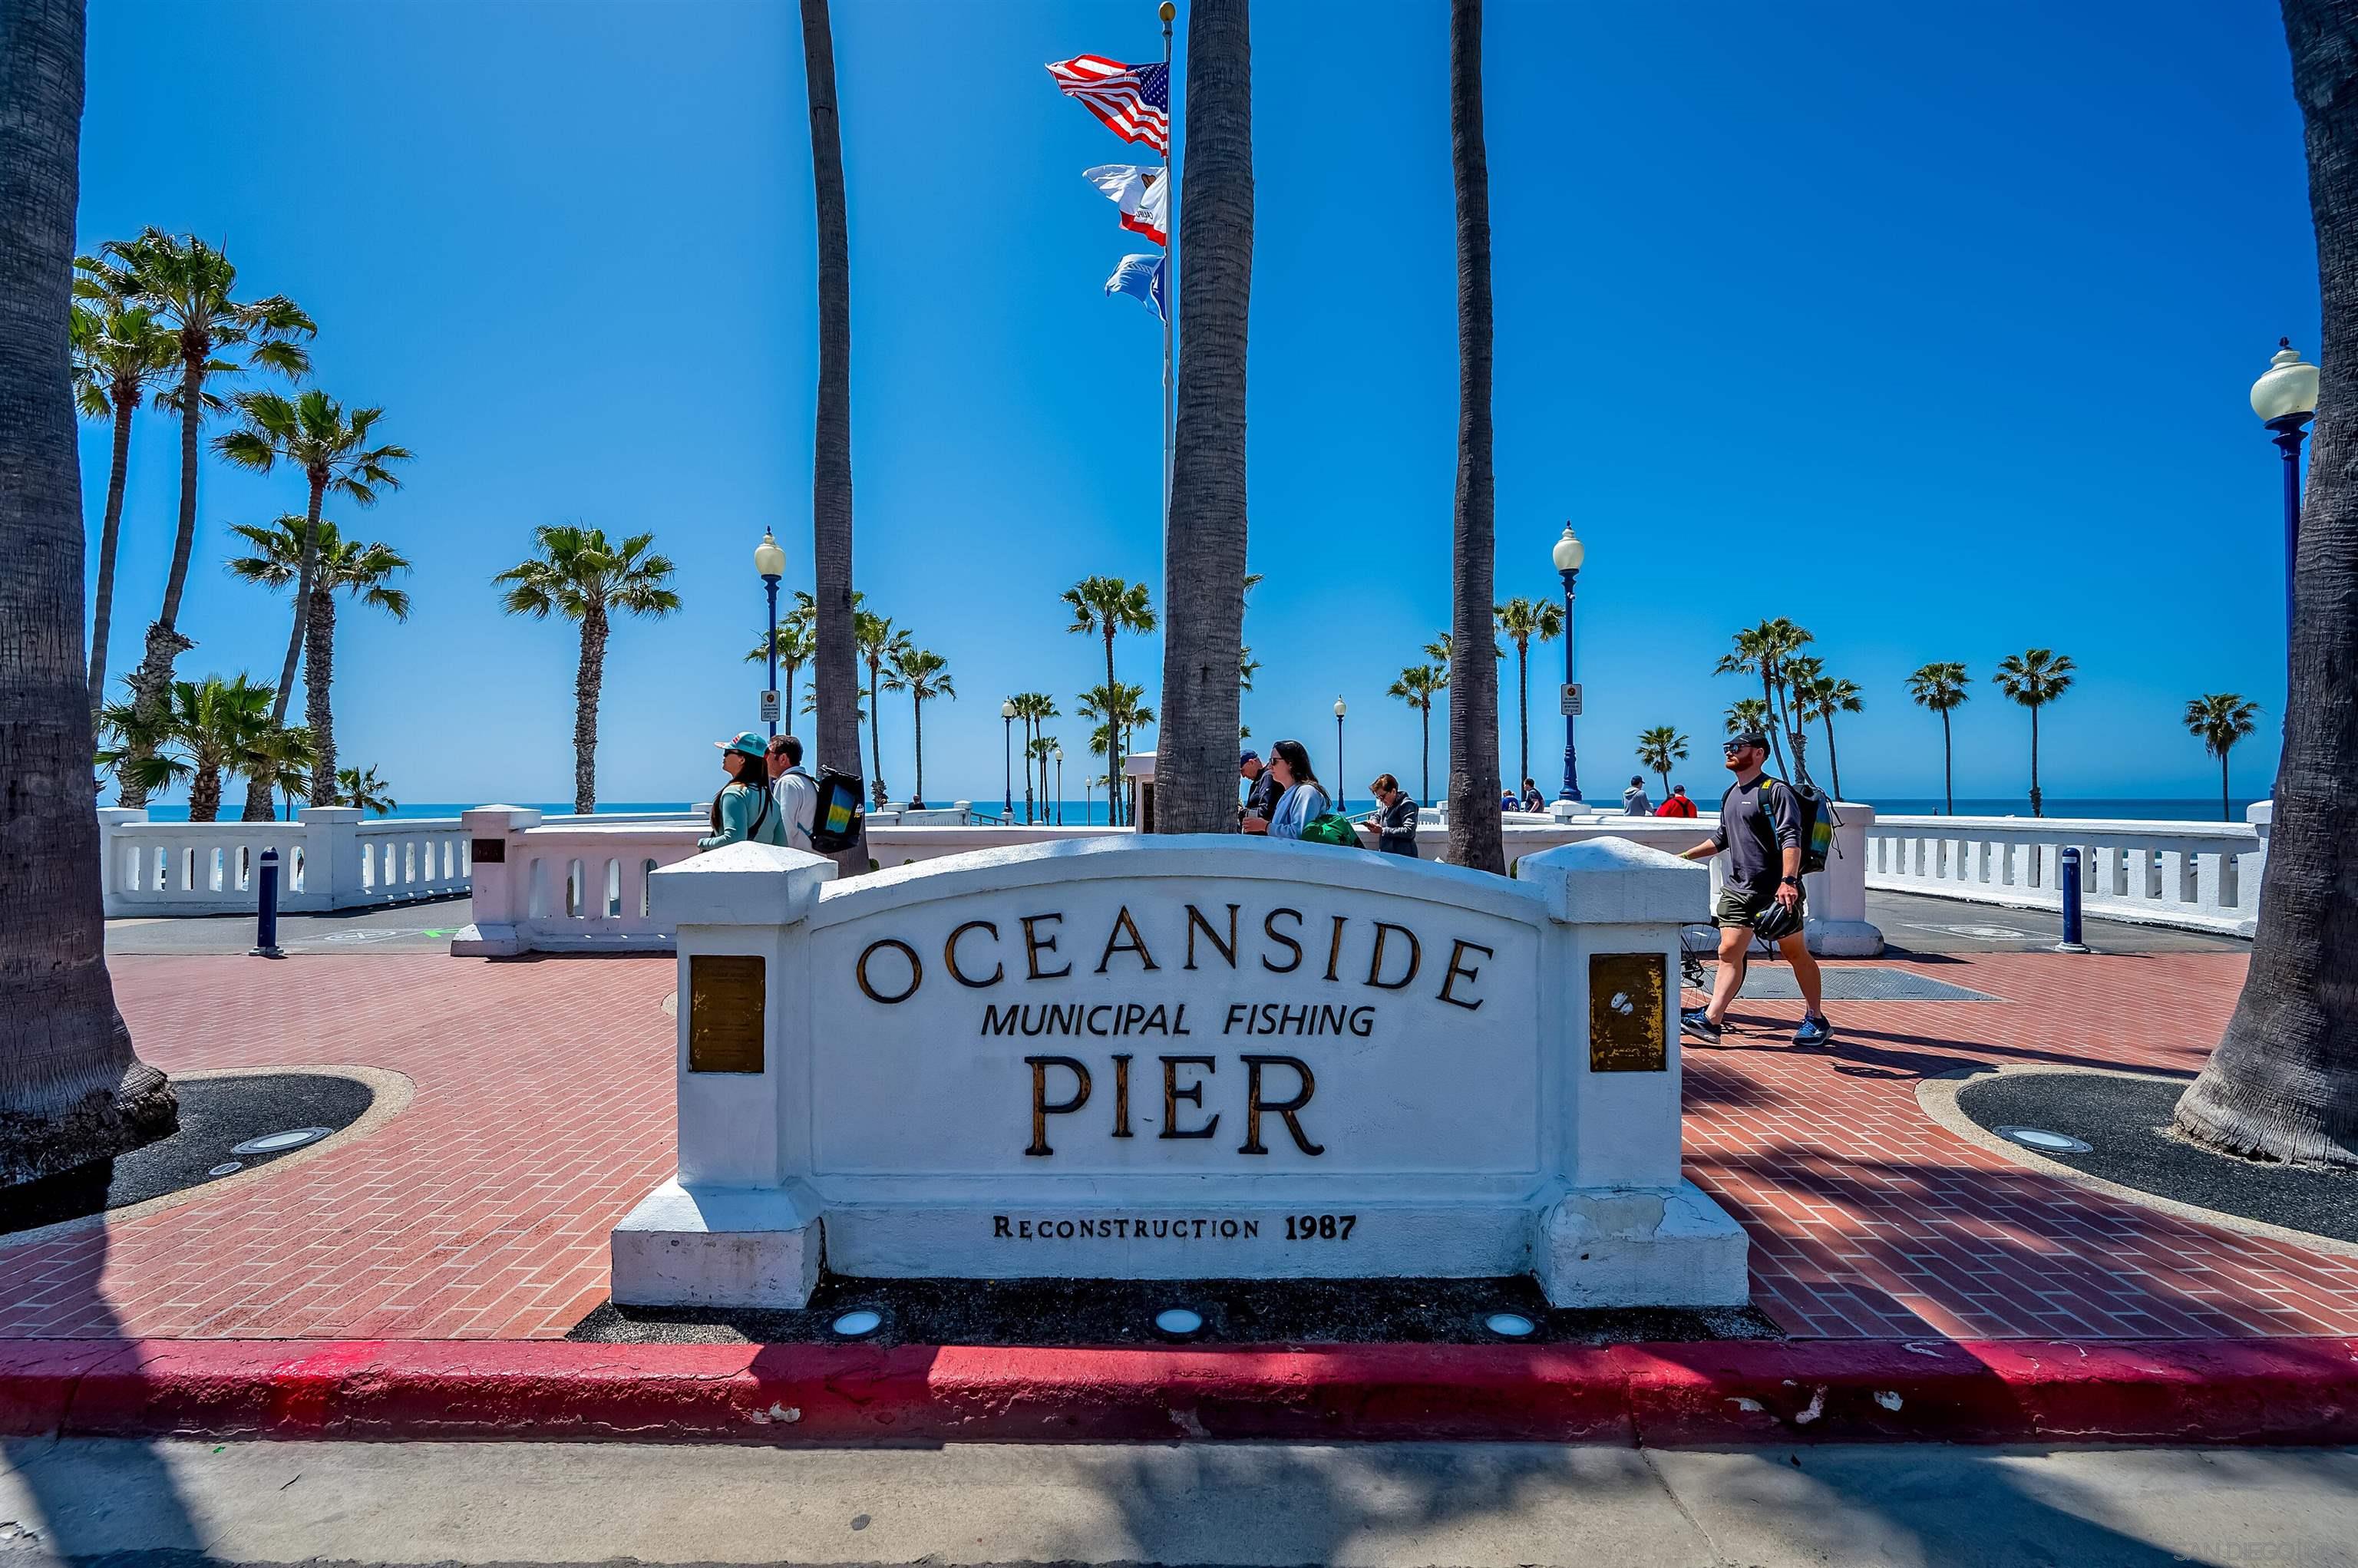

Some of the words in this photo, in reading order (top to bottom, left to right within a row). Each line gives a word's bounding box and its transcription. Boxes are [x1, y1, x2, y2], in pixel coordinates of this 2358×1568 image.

[856, 903, 1494, 1012] OCEANSIDE
[980, 1003, 1191, 1037] MUNICIPAL
[1222, 1003, 1376, 1037] FISHING
[1023, 1053, 1326, 1157] PIER
[992, 1214, 1260, 1242] RECONSTRUCTION
[1285, 1214, 1357, 1241] 1987
